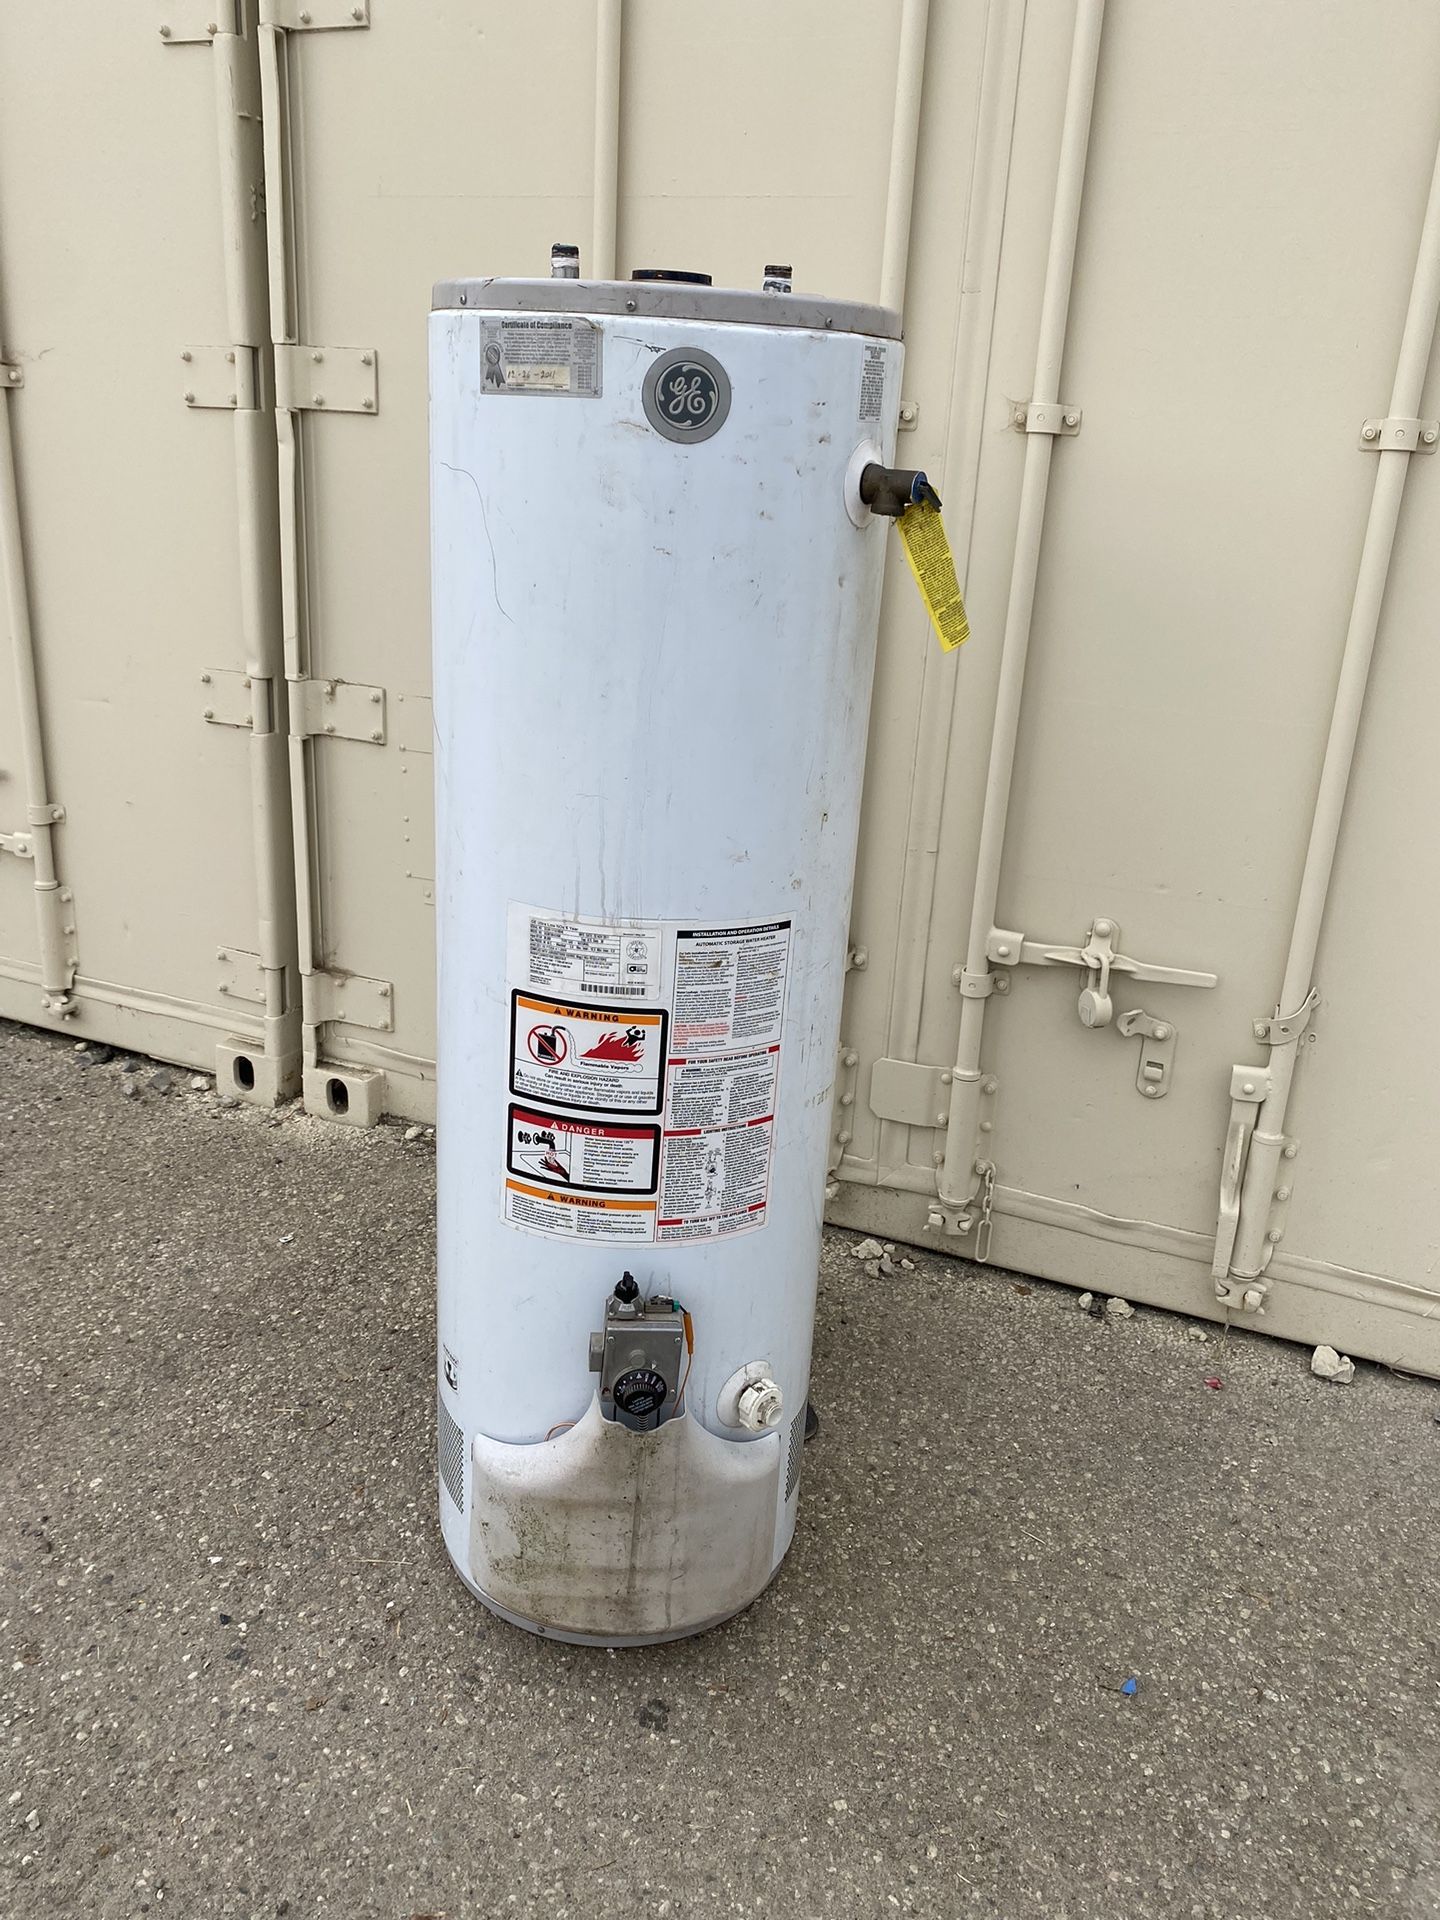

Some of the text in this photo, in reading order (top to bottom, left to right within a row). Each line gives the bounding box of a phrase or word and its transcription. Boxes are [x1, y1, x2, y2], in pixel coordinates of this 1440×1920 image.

[502, 321, 572, 330] Certificate of Compliance
[738, 926, 763, 935] OPERATION
[763, 924, 780, 932] DETAILS
[566, 1009, 619, 1023] WARNING
[580, 1061, 609, 1069] Flammable
[571, 1073, 597, 1081] EXPLOSION
[562, 1123, 605, 1136] DANGER
[560, 1195, 606, 1208] WARNING
